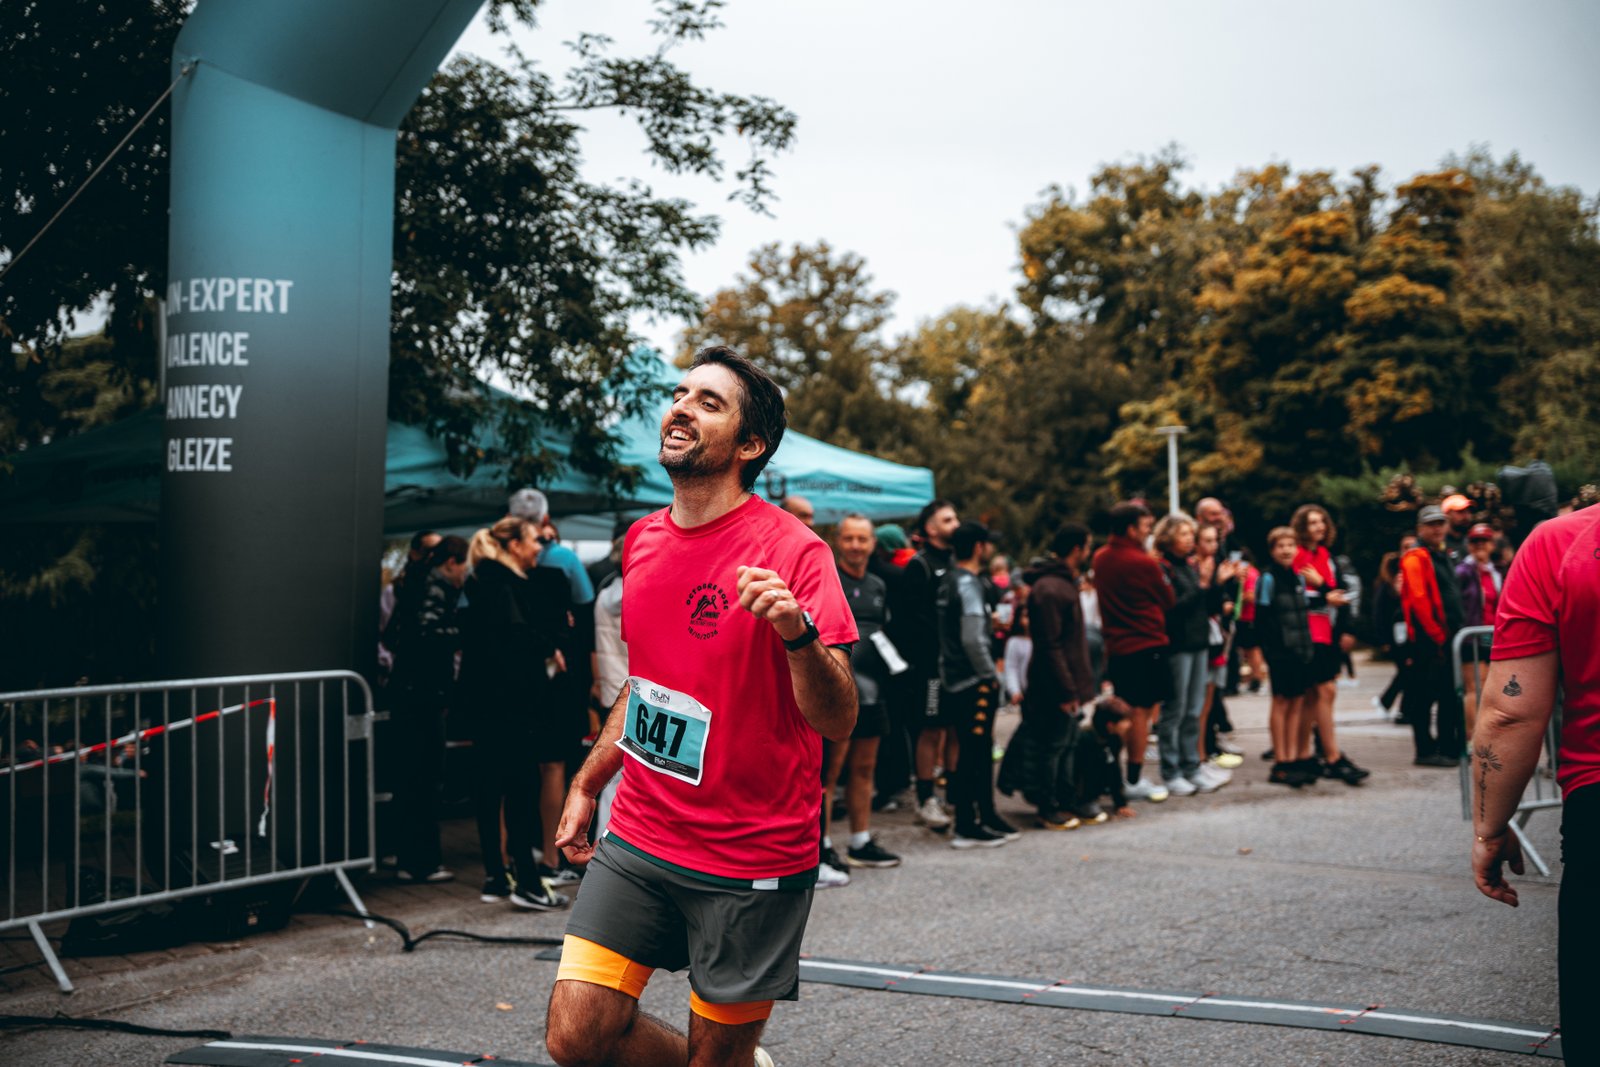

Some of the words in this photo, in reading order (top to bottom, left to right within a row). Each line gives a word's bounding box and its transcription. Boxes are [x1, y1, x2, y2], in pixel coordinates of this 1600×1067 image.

[167, 277, 294, 316] N-EXPERT
[167, 331, 249, 368] ALENCE
[167, 384, 243, 419] ANNECY
[167, 437, 233, 472] GLEIZE
[635, 703, 687, 758] 647
